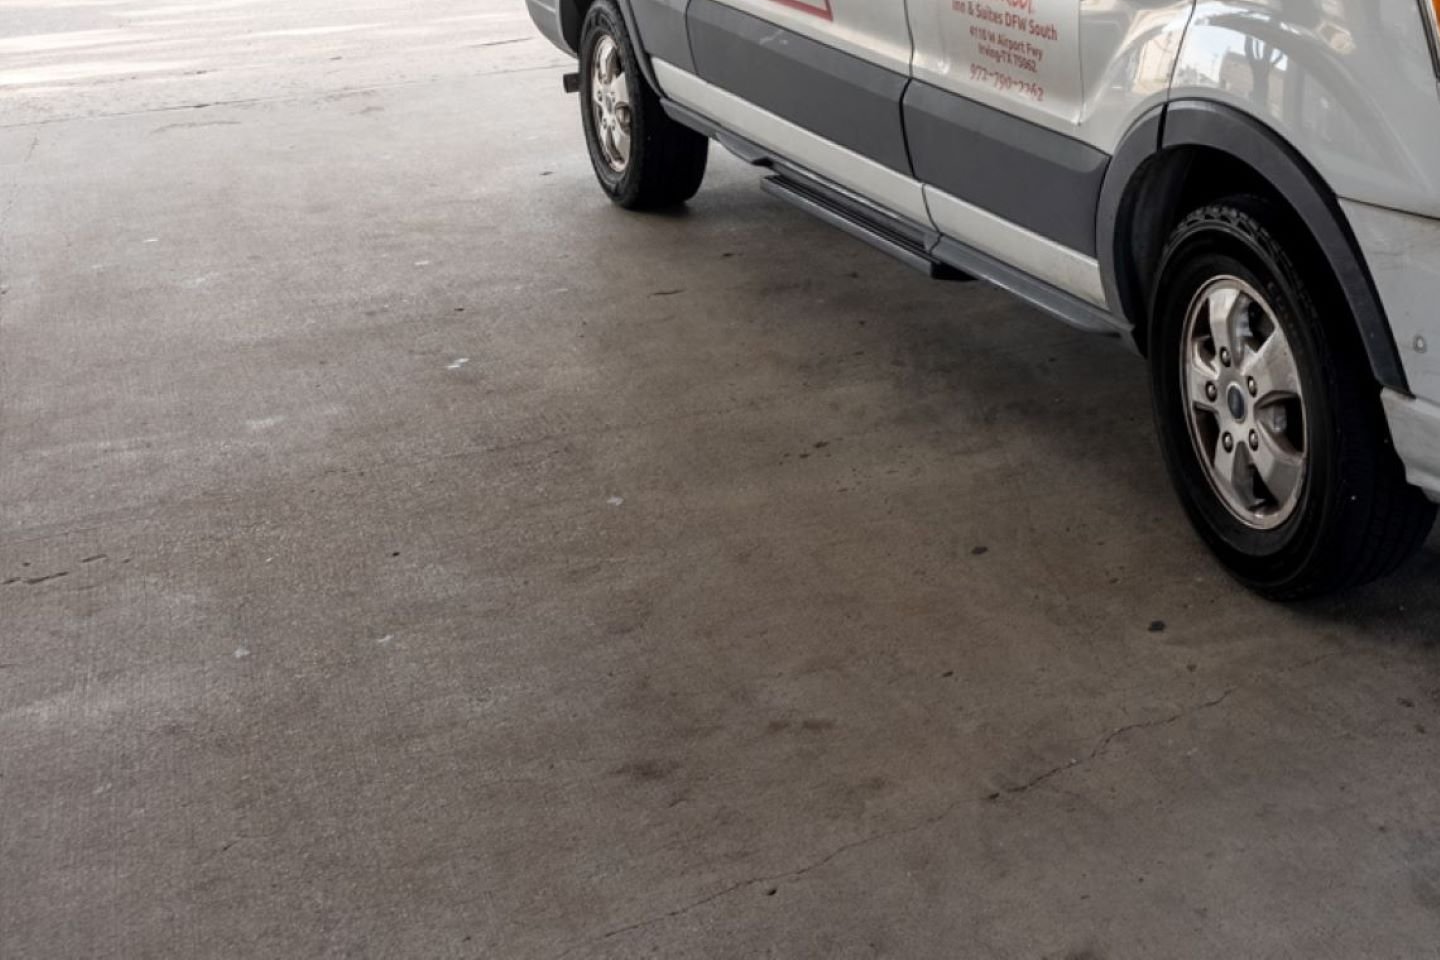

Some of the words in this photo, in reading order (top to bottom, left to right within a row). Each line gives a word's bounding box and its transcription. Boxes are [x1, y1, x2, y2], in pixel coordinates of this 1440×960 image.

[967, 0, 975, 16] &
[975, 3, 1003, 25] Suites
[1004, 11, 1026, 31] DFW
[1028, 19, 1058, 41] South
[997, 33, 1024, 54] Airport
